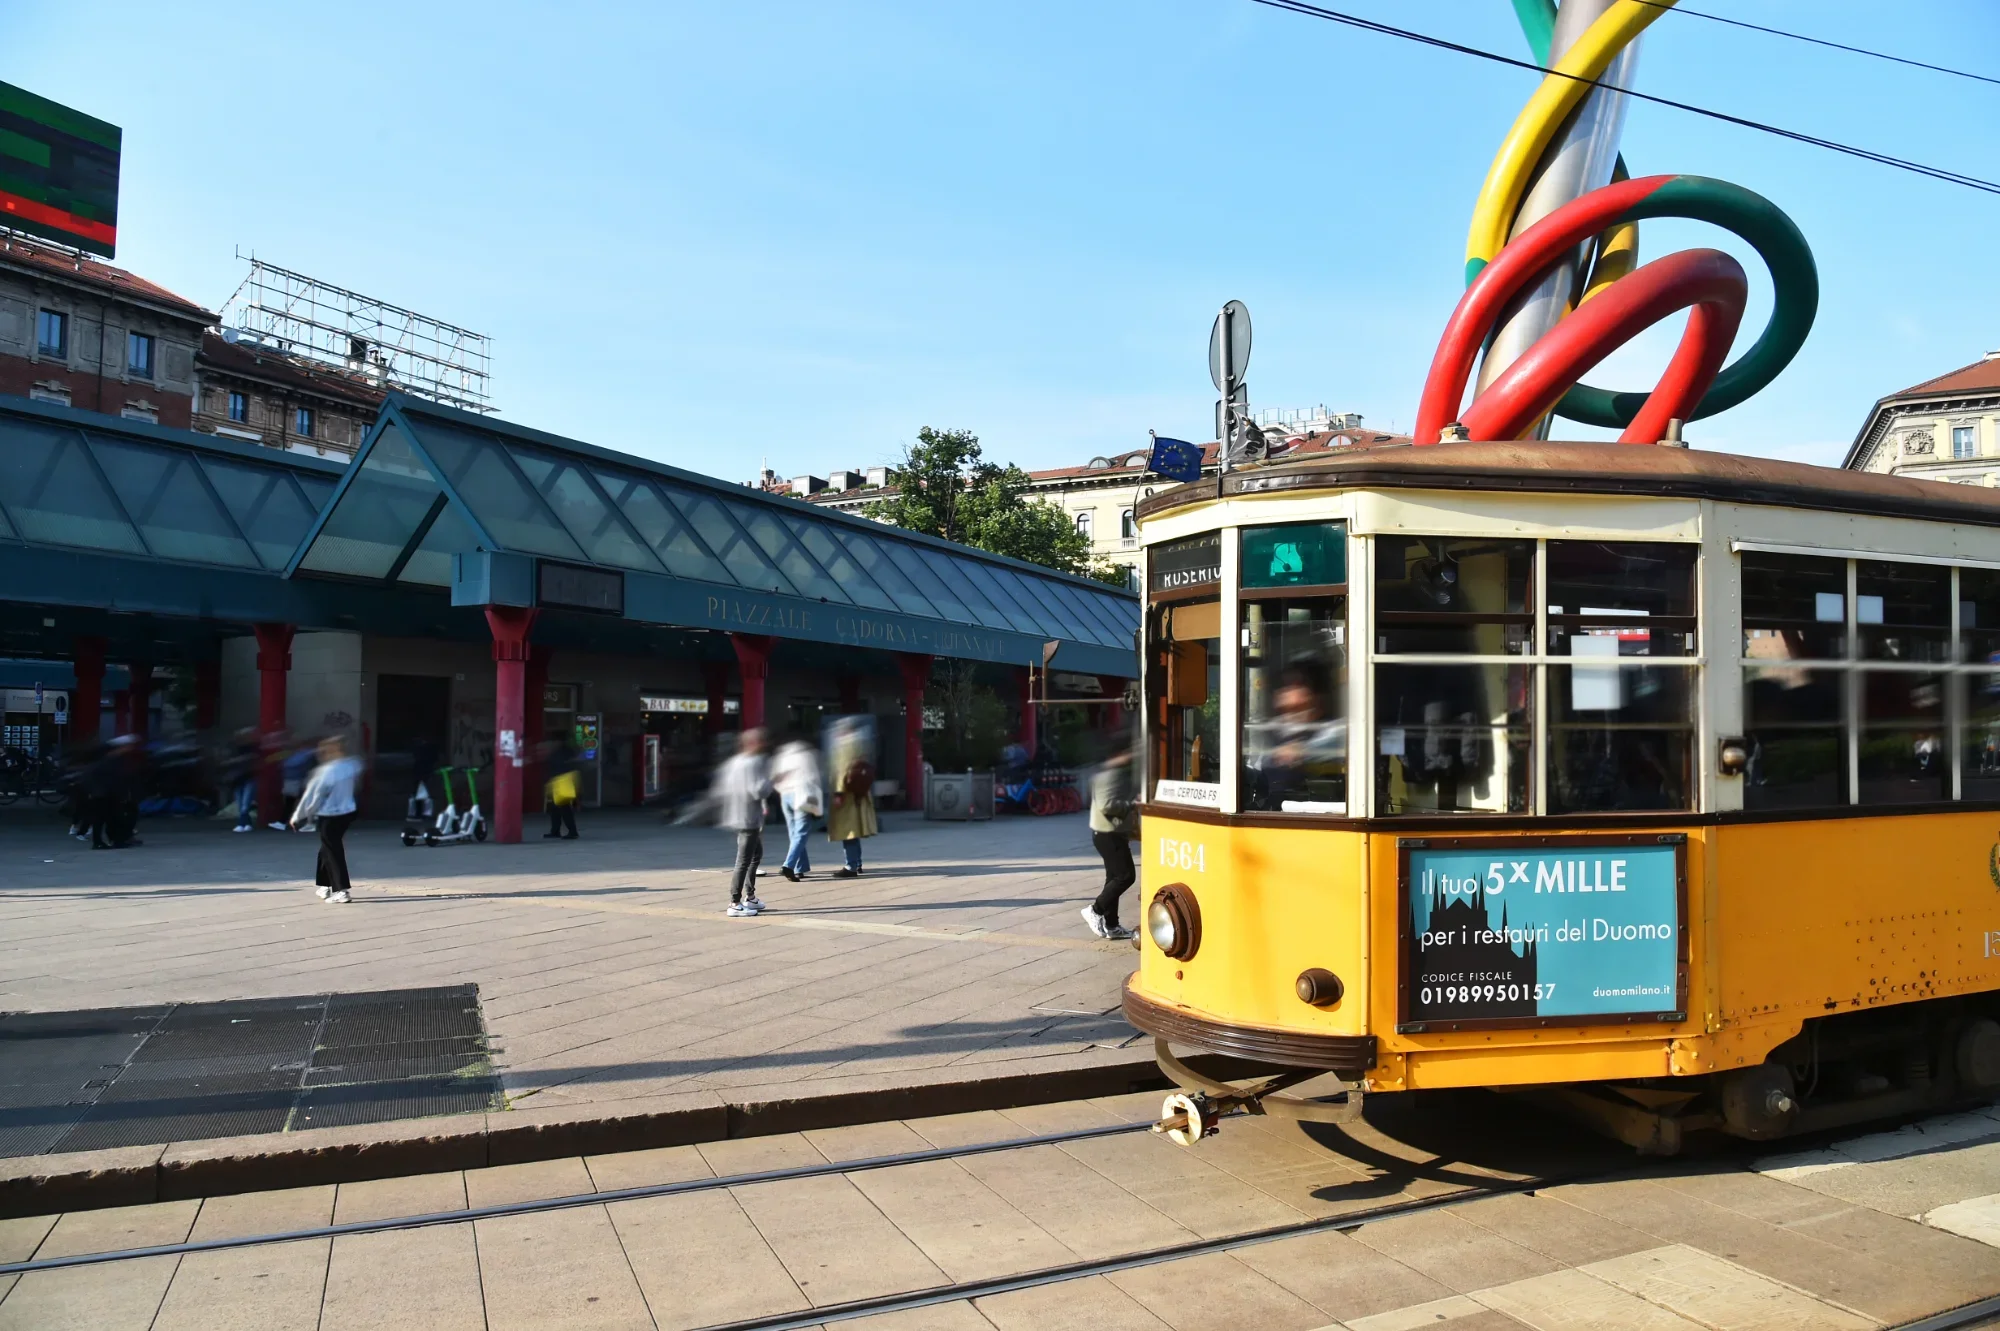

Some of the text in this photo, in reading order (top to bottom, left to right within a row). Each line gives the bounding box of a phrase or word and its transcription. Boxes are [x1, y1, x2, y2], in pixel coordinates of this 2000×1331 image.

[707, 597, 812, 631] PIAZZALE
[836, 617, 919, 644] CADORNA
[649, 699, 671, 710] BAR
[1177, 787, 1207, 800] CERTOSA
[1208, 790, 1218, 801] FS
[1160, 837, 1205, 873] 1564
[1421, 869, 1433, 895] Il
[1441, 873, 1478, 895] tuo
[1421, 918, 1672, 952] per i restauri del Duomo
[1421, 971, 1513, 983] CODICE FISCALE
[1421, 983, 1556, 1005] 01989950157
[1593, 984, 1670, 998] duomomilano.it
